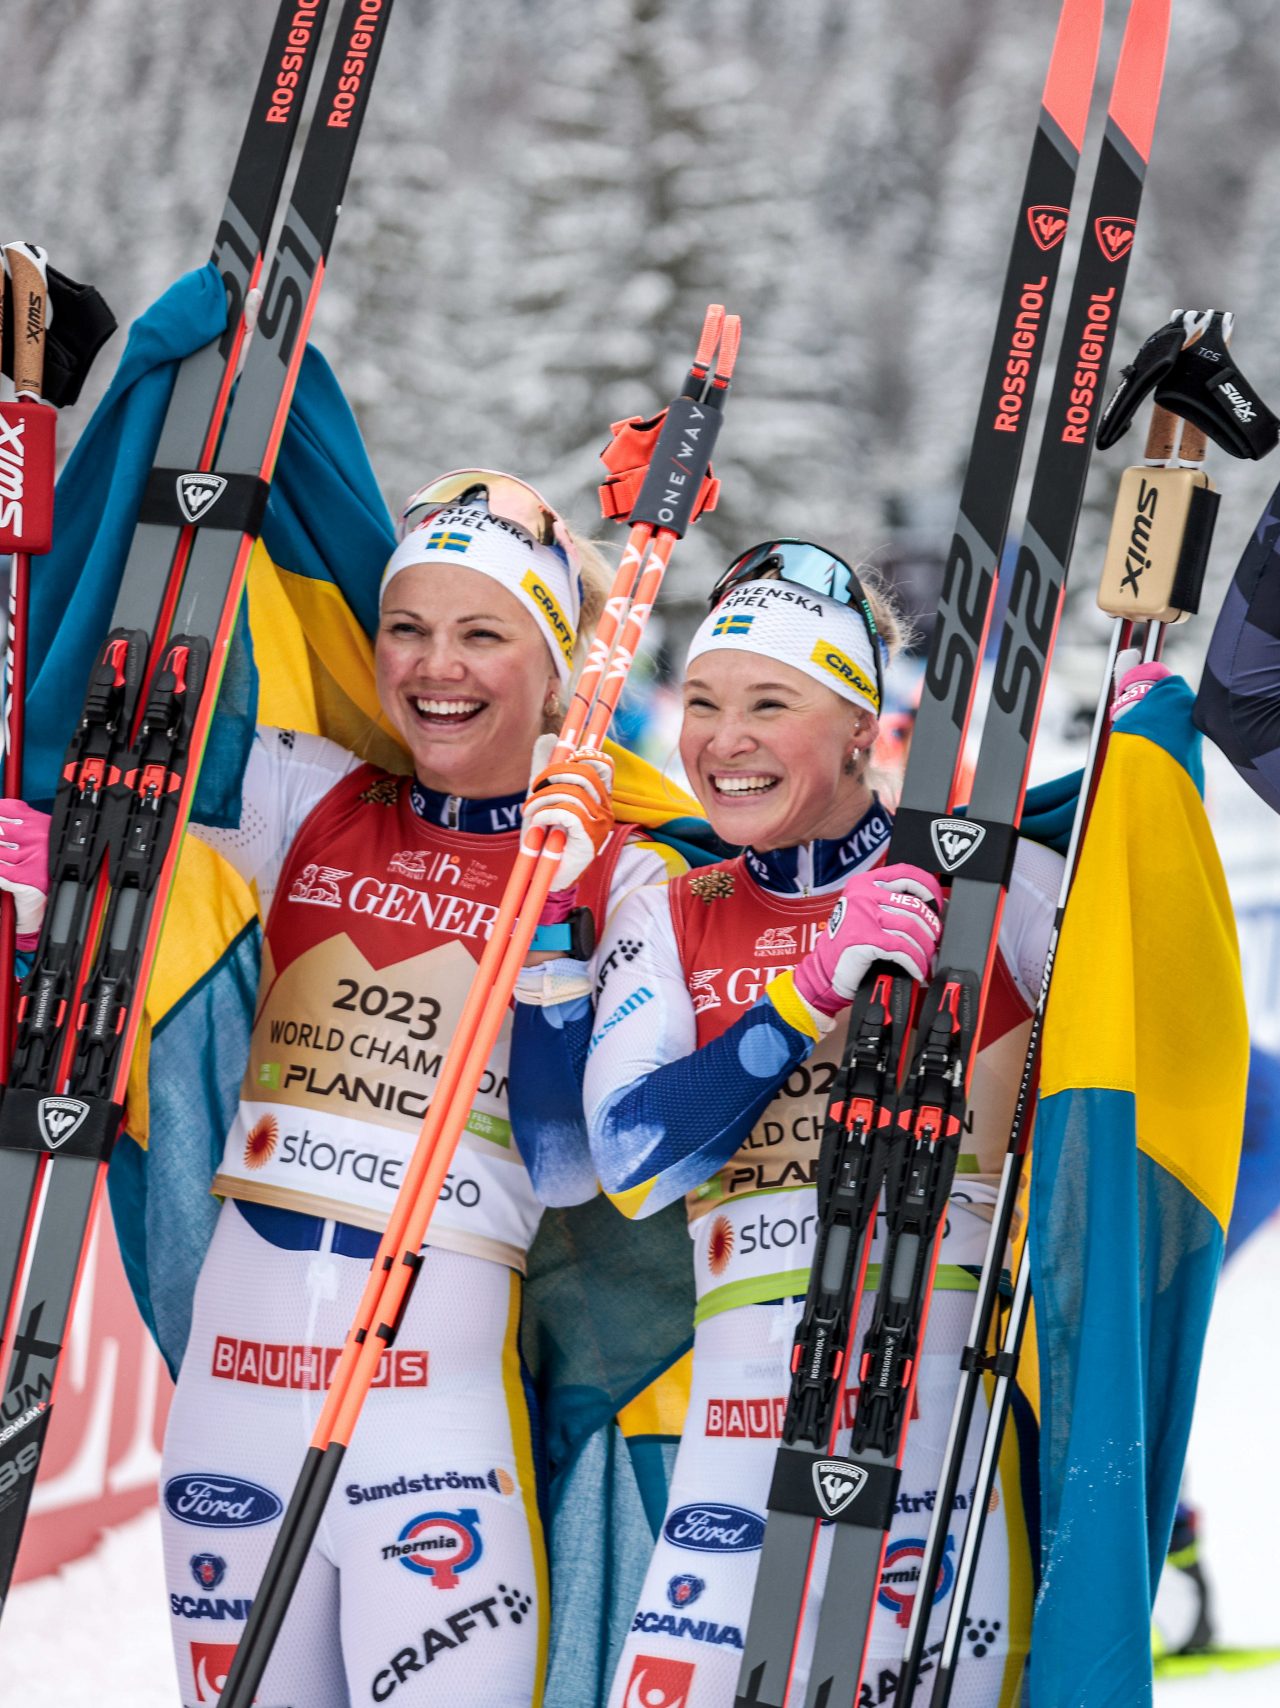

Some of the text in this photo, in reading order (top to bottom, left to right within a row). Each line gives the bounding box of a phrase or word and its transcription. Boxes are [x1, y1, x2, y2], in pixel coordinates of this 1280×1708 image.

[994, 276, 1048, 432] ROSSIGNOL
[1062, 287, 1115, 444] ROSSIGNOL
[434, 516, 487, 532] SPEL
[442, 507, 534, 551] SVENSKA
[533, 584, 572, 644] CRAFT
[722, 596, 769, 610] SPEL
[731, 586, 824, 617] SVENSKA
[926, 533, 999, 732] S2
[992, 545, 1065, 743] S2
[490, 806, 523, 831] LY
[837, 816, 889, 868] LYKO
[349, 877, 501, 941] GENER
[890, 892, 942, 932] HESTRA
[332, 978, 441, 1041] 2023
[270, 1020, 344, 1052] WORLD
[284, 1064, 431, 1120] PLANIC
[279, 1130, 481, 1207] storaeso
[811, 1336, 825, 1380] ROSSIGNOL
[880, 1344, 893, 1388] ROSSIGNOL
[345, 1472, 487, 1505] Sundström
[819, 1464, 861, 1480] ROSSIGNOL
[177, 1480, 254, 1520] Ford
[381, 1535, 458, 1560] Thermia
[672, 1508, 745, 1547] Ford
[371, 1596, 499, 1703] CRAFT
[631, 1612, 745, 1649] SCANIA
